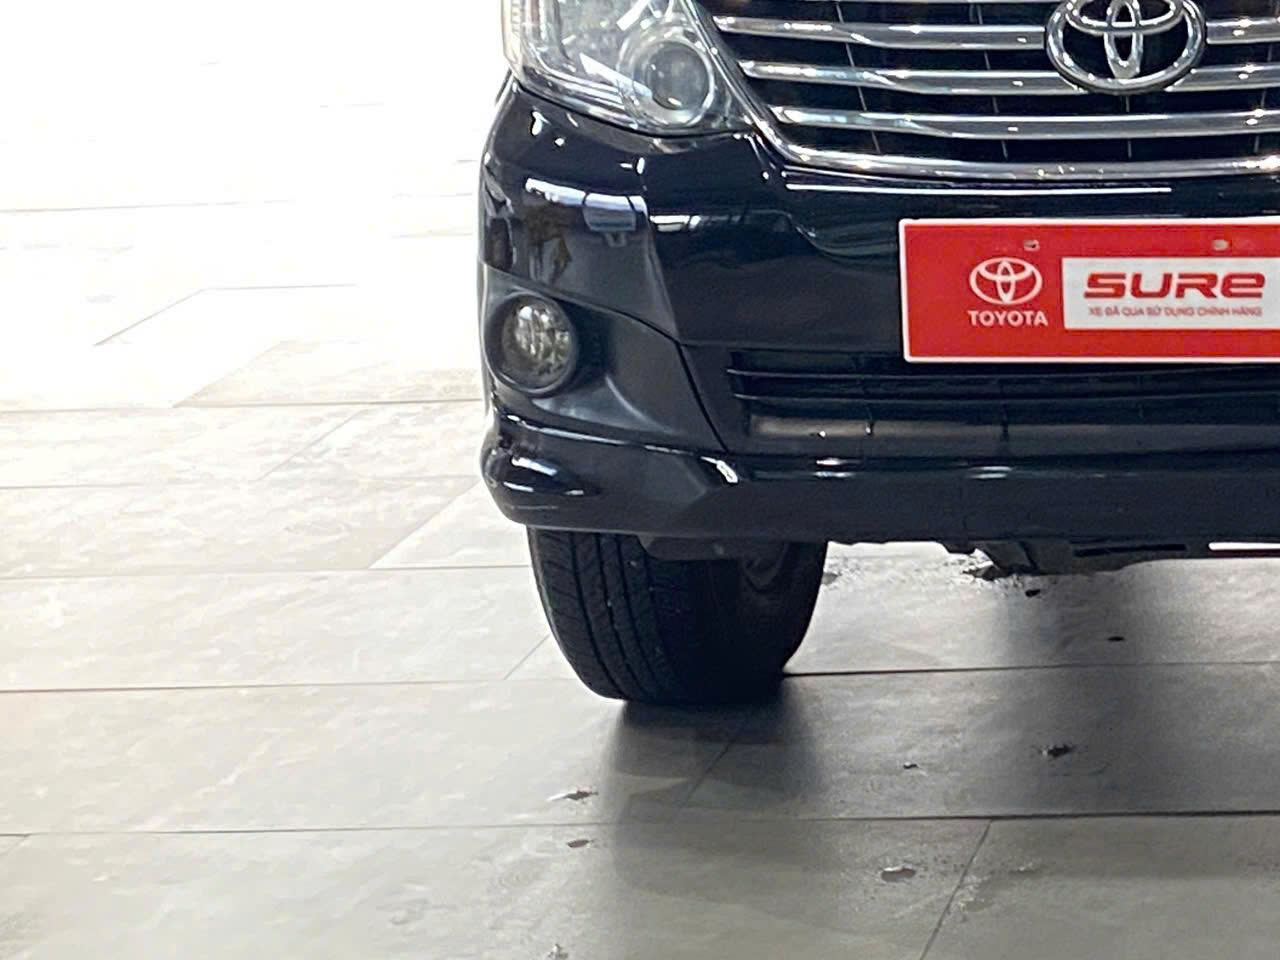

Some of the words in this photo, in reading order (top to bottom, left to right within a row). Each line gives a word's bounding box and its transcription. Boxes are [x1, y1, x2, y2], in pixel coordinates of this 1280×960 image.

[967, 310, 1048, 327] TOYOTA
[1089, 307, 1101, 316] XE
[1122, 307, 1144, 317] QUA
